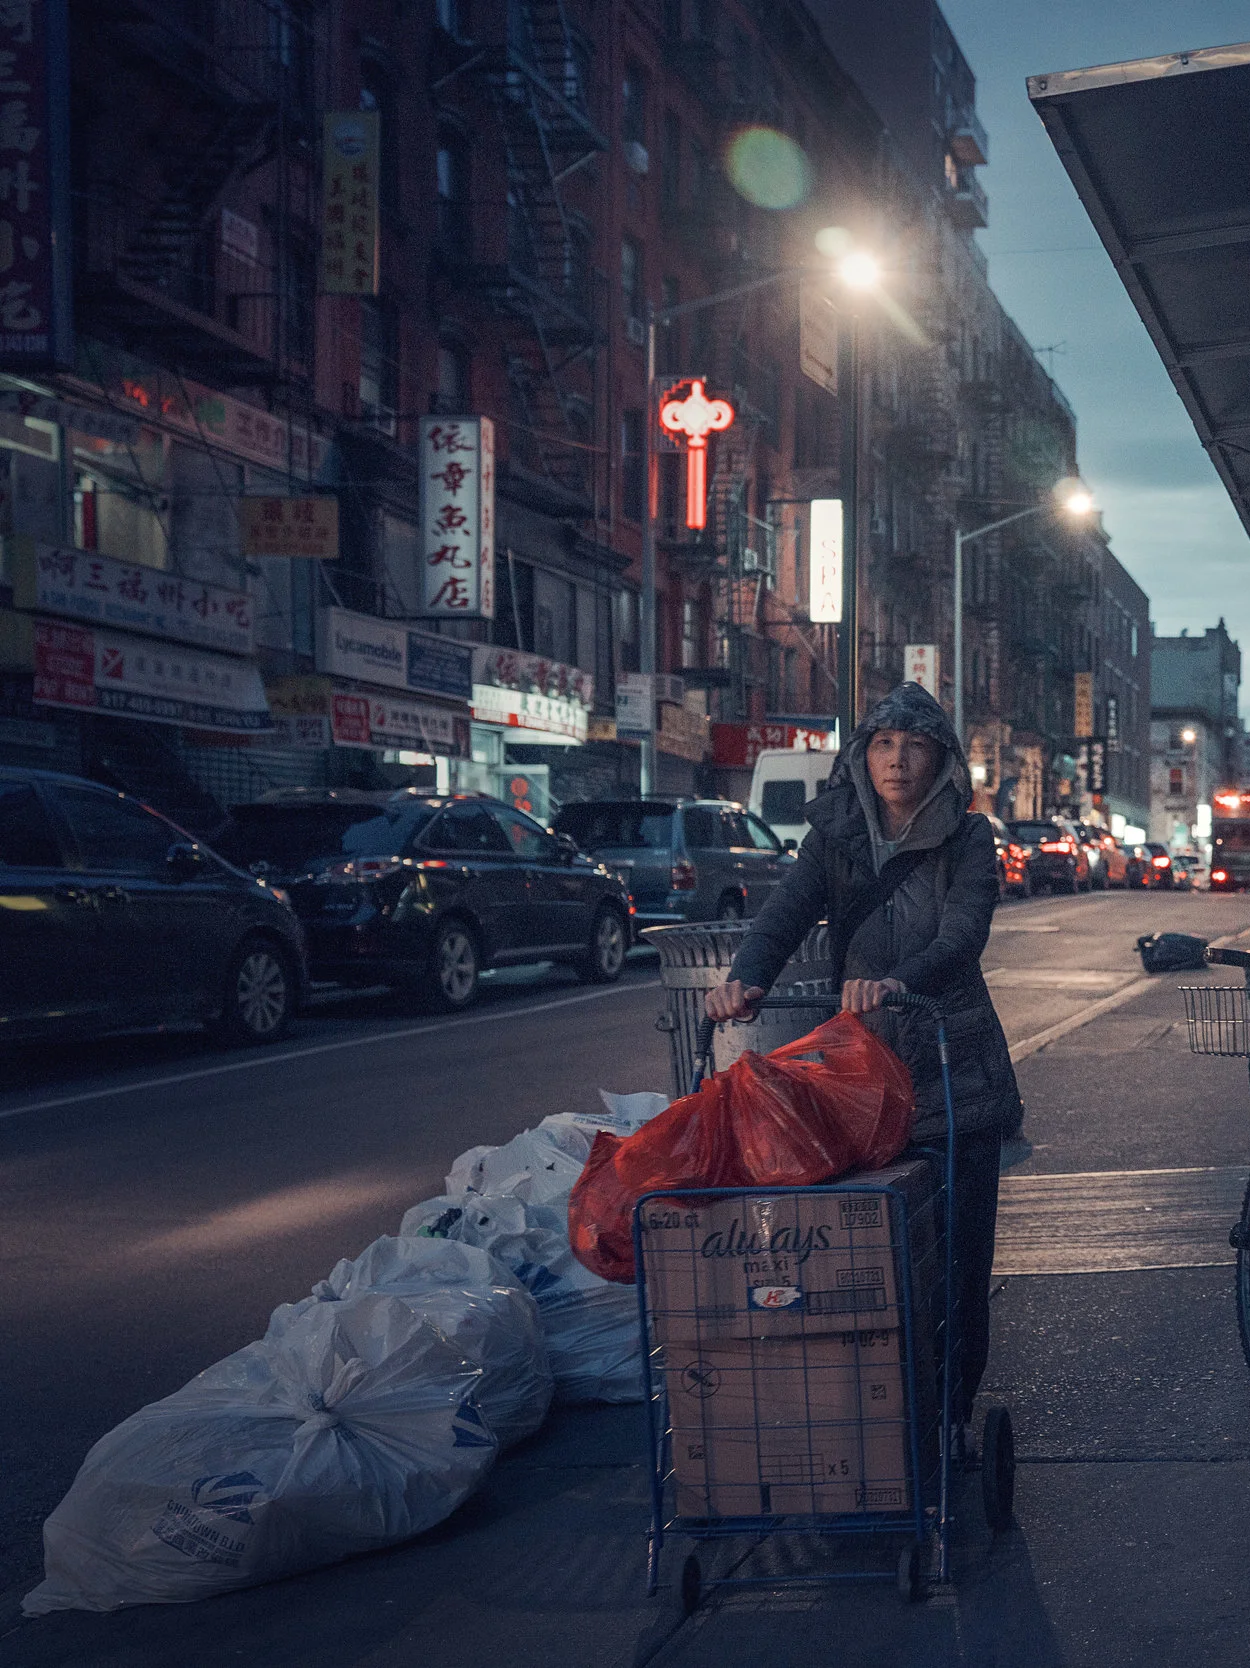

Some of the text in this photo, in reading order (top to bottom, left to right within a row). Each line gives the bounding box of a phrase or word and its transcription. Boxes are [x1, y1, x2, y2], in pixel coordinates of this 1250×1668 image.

[648, 1210, 700, 1230] 6-20 ct
[701, 1218, 833, 1265] always
[743, 1255, 789, 1274] maxi
[781, 1274, 792, 1287] 5
[828, 1459, 849, 1475] x 5
